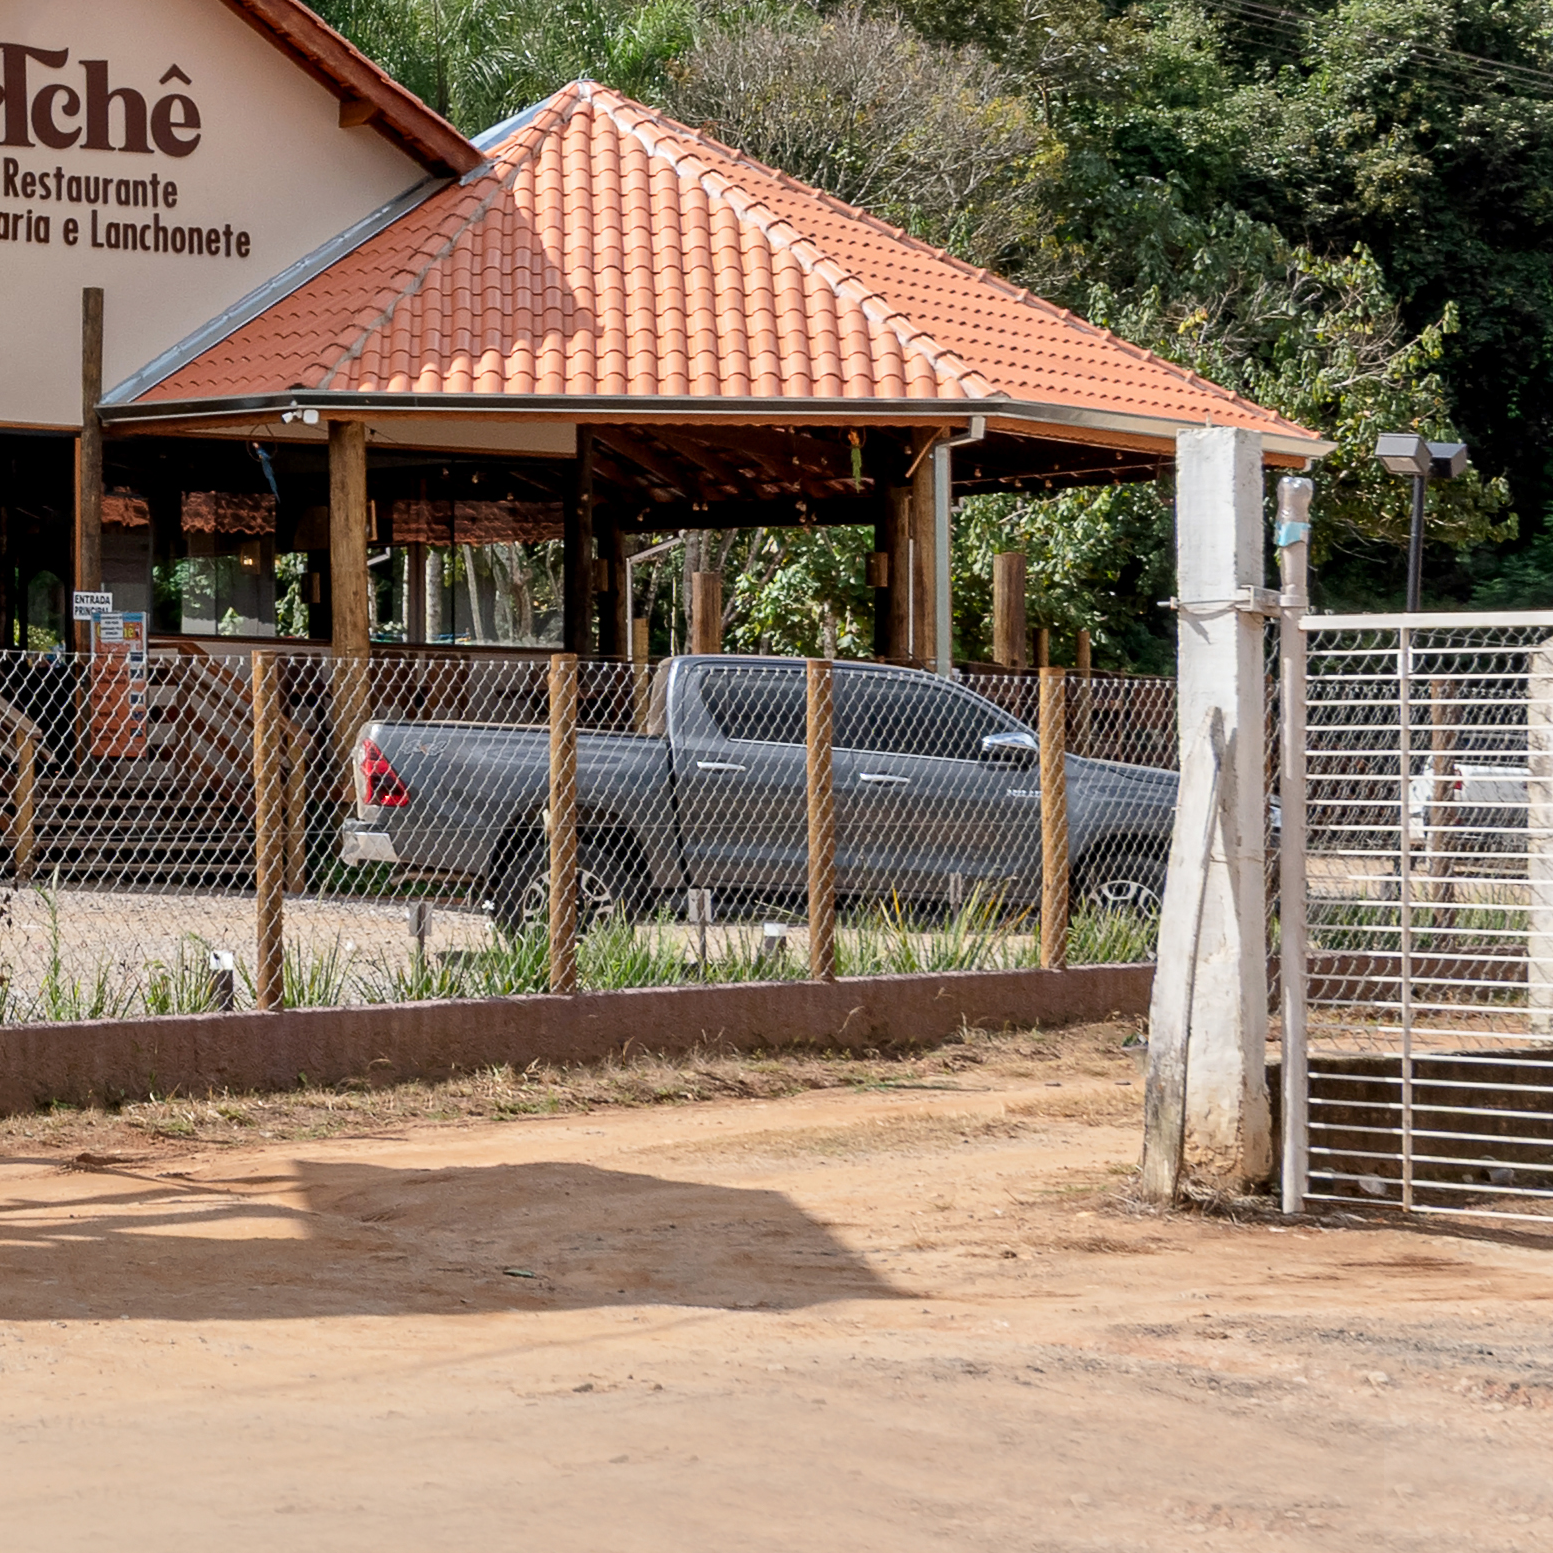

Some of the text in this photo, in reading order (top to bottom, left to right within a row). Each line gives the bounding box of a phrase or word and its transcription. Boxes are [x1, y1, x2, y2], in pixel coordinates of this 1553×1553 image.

[3, 157, 178, 208] Restaurante
[62, 217, 79, 246] e
[91, 209, 251, 258] Lanchonete
[75, 595, 110, 604] ENTRADA
